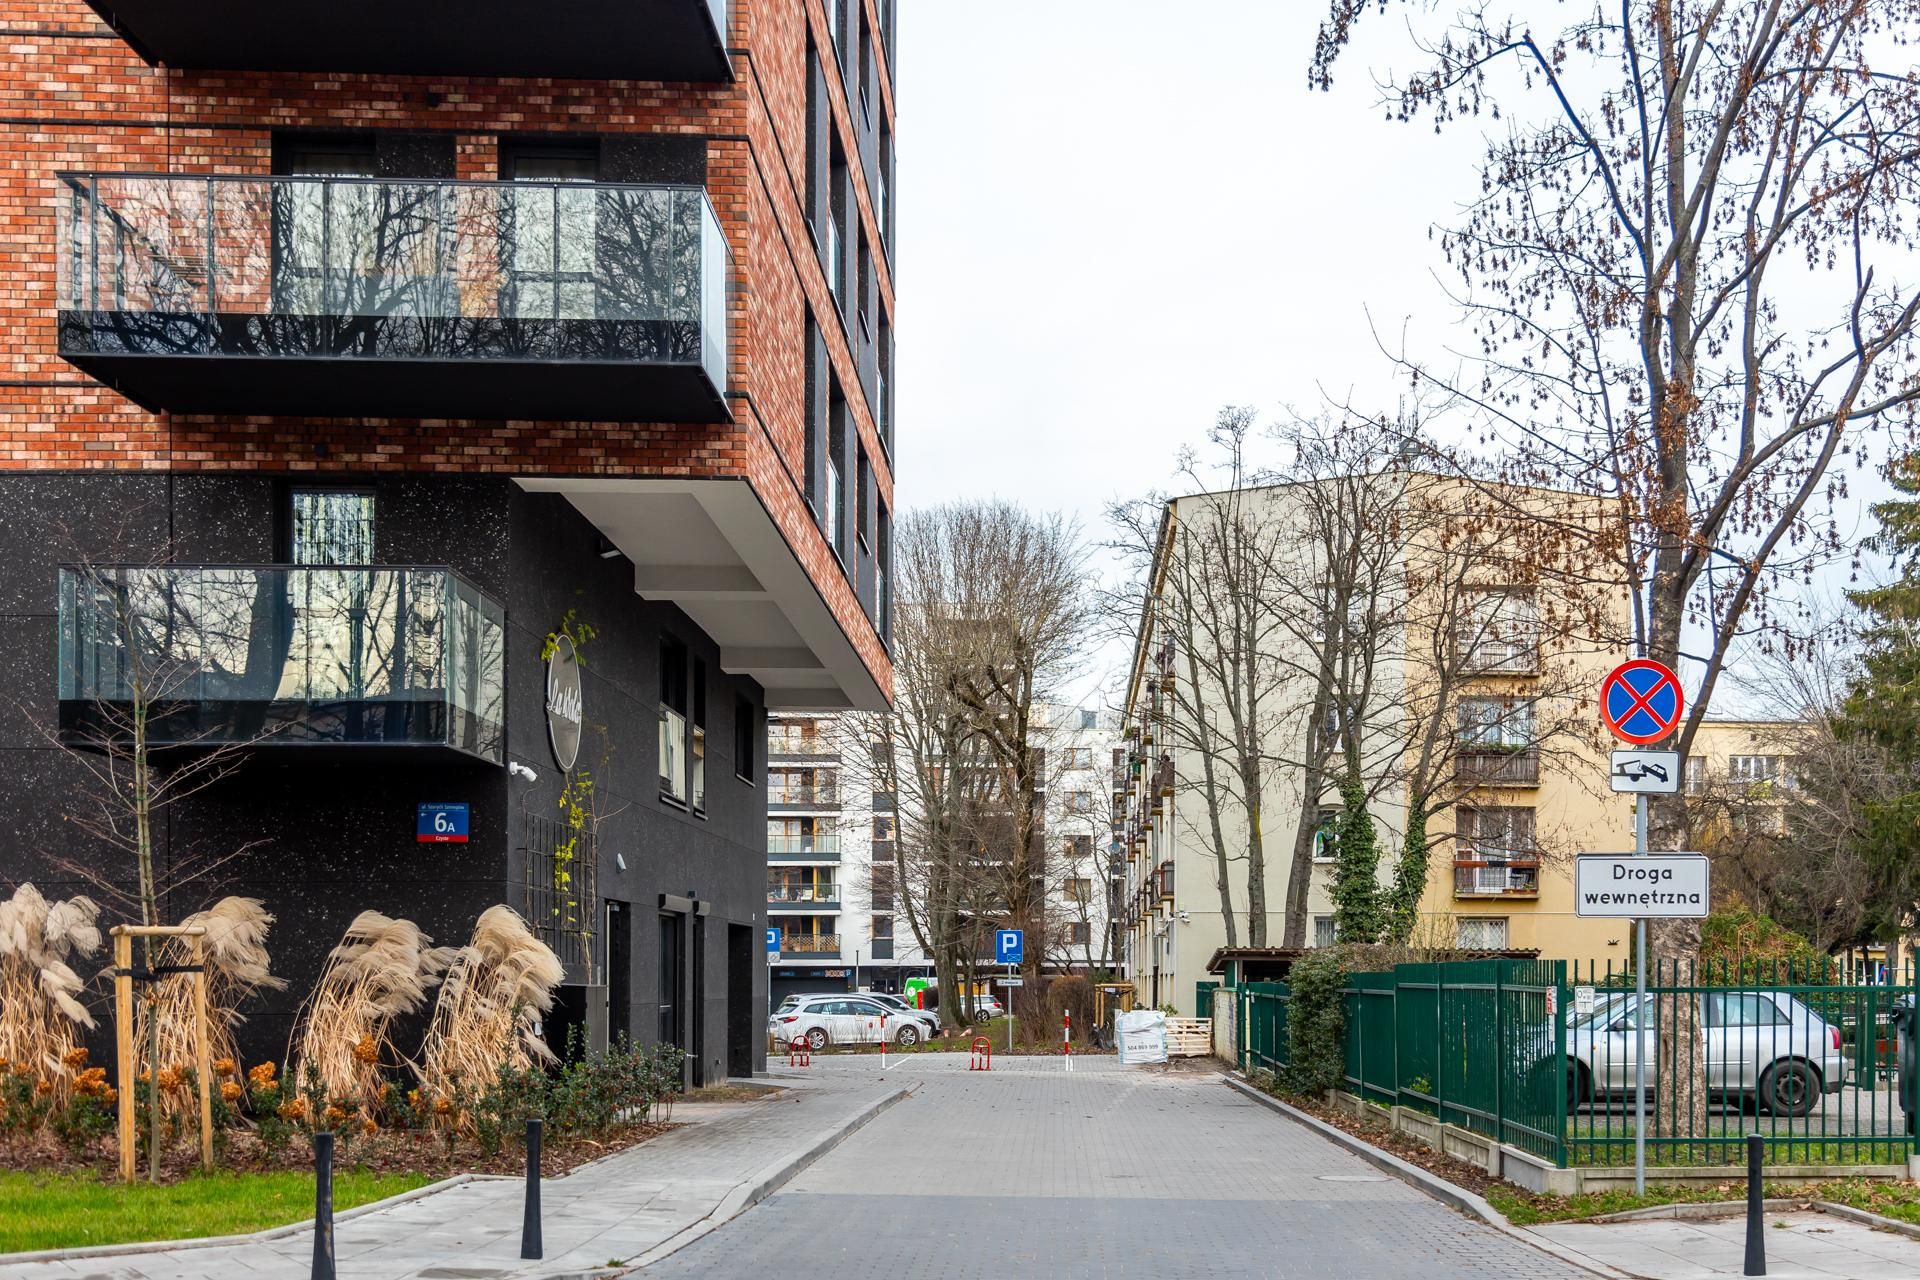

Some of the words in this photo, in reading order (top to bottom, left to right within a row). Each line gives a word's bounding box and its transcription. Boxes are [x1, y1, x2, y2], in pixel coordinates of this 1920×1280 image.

[434, 812, 455, 832] 6A
[1613, 864, 1673, 884] Droga
[1585, 889, 1700, 909] wewnętrzna
[1003, 933, 1018, 954] P
